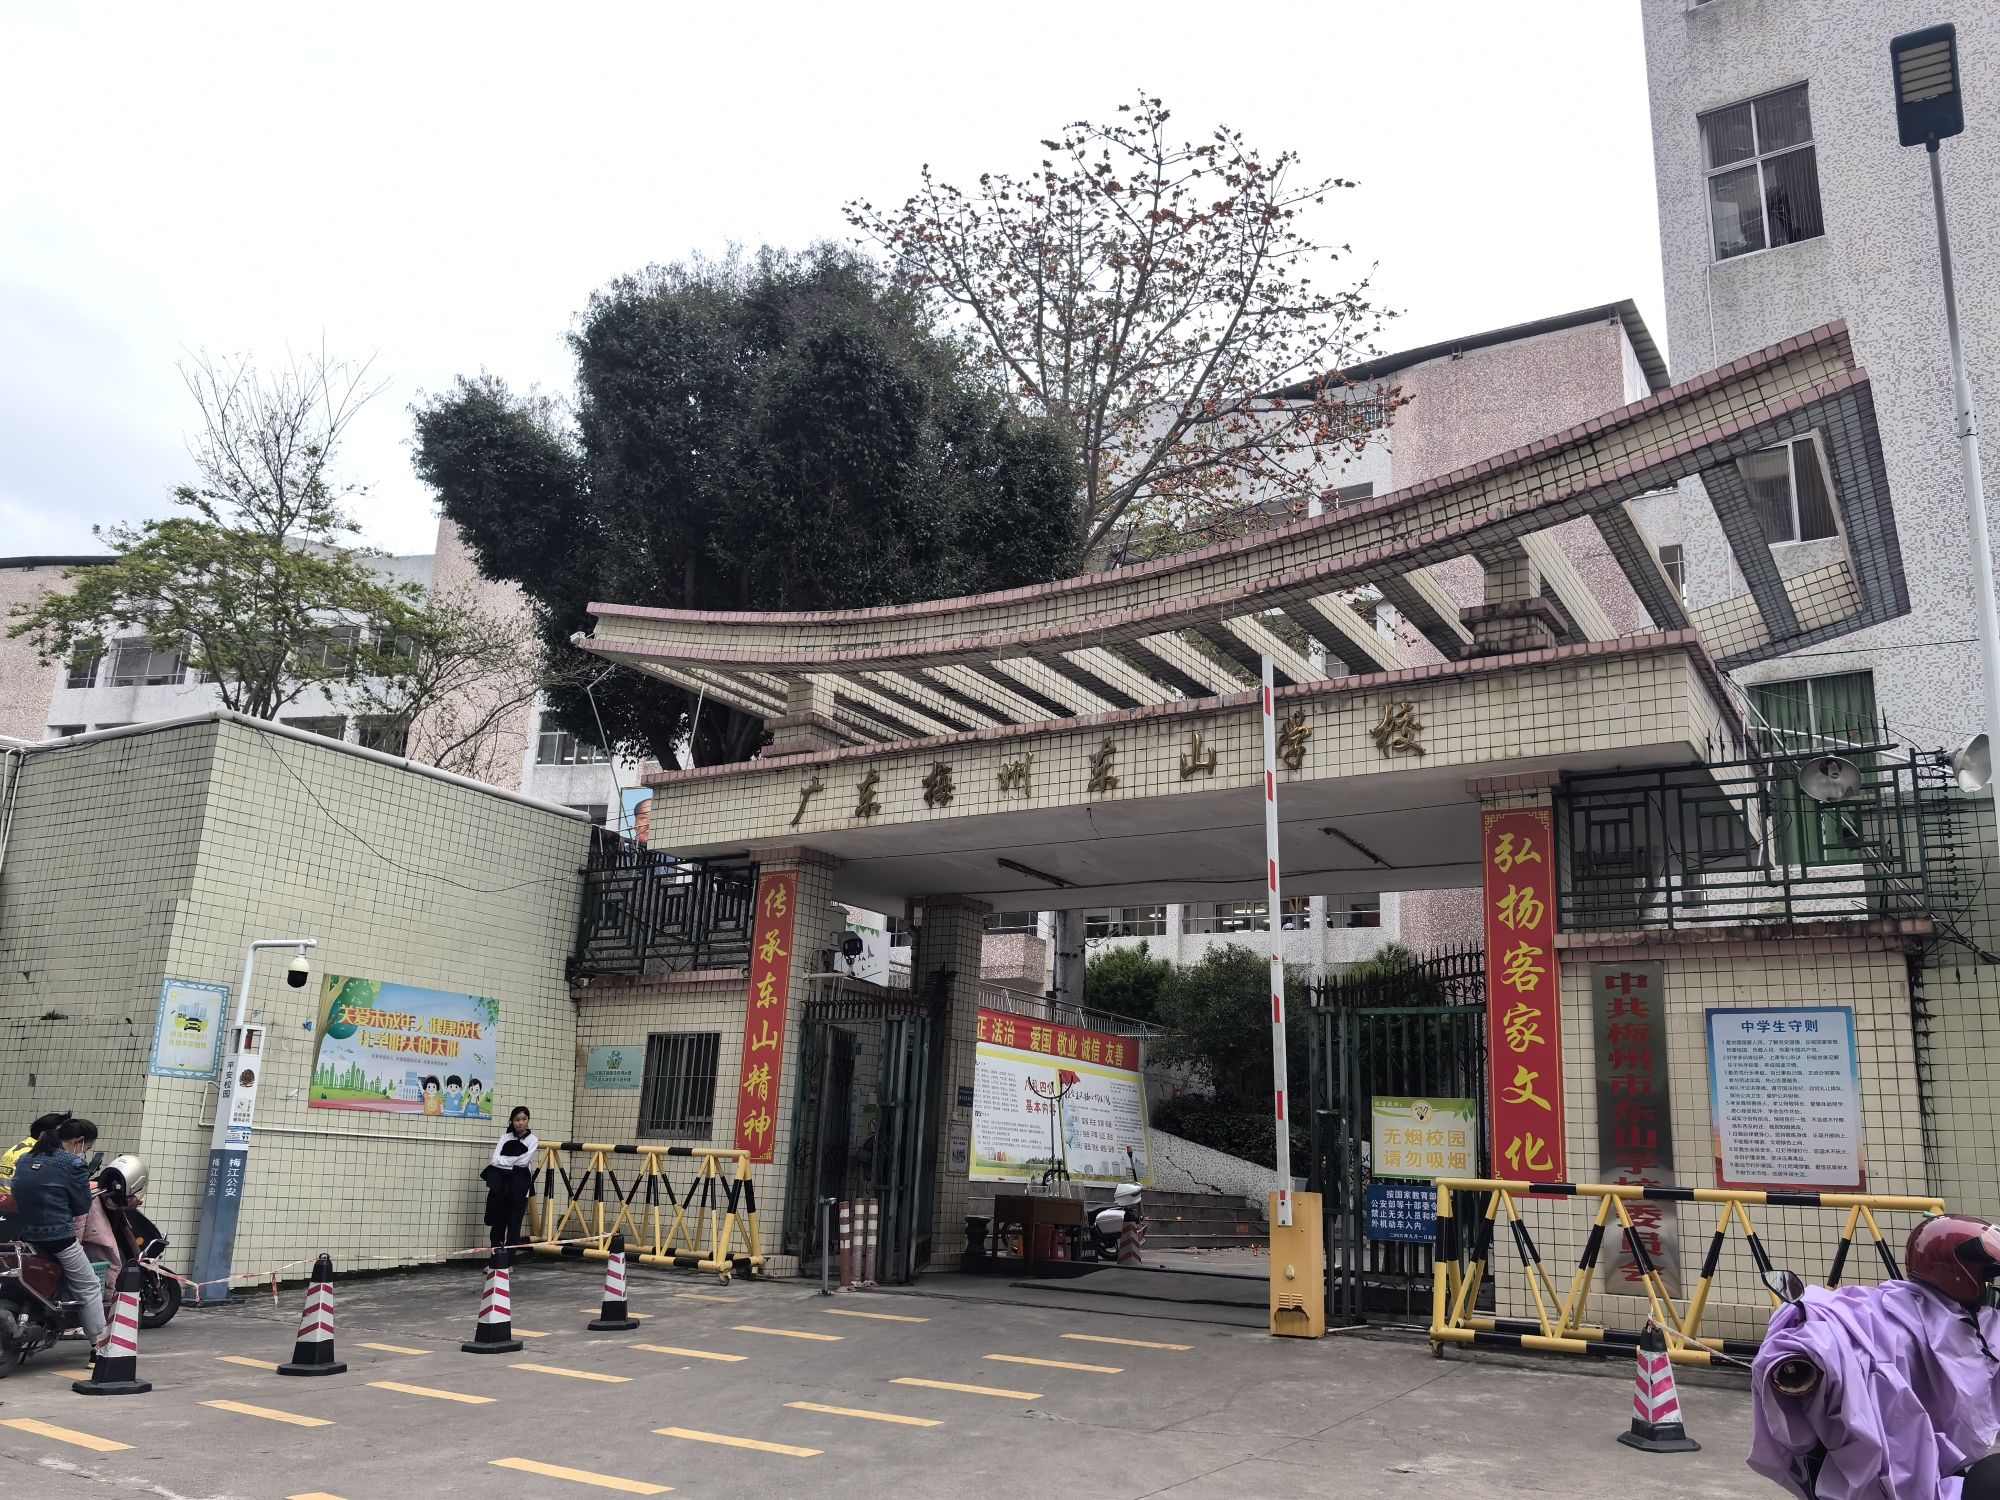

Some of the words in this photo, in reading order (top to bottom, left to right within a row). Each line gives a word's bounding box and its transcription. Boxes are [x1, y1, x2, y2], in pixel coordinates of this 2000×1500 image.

[743, 882, 788, 1148] 传承东山精神
[1493, 833, 1555, 1171] 弘扬客家文化
[339, 1004, 483, 1041] 关爱未成年人健康成长
[1741, 1019, 1819, 1033] 中学生守则
[992, 1017, 1016, 1046] 法治
[1030, 1025, 1053, 1053] 爱国
[1057, 1031, 1078, 1058] 敬业
[1081, 1037, 1101, 1062] 诚信
[1105, 1041, 1125, 1067] 友善
[223, 1061, 234, 1098] 平安校园
[1026, 1098, 1056, 1117] 基本内容
[1384, 1128, 1466, 1148] 无烟校园
[208, 1157, 220, 1197] 梅江公安
[225, 1157, 241, 1197] 梅江公安
[1384, 1149, 1467, 1170] 请勿吸烟
[1386, 1189, 1437, 1200] 按国家教育部
